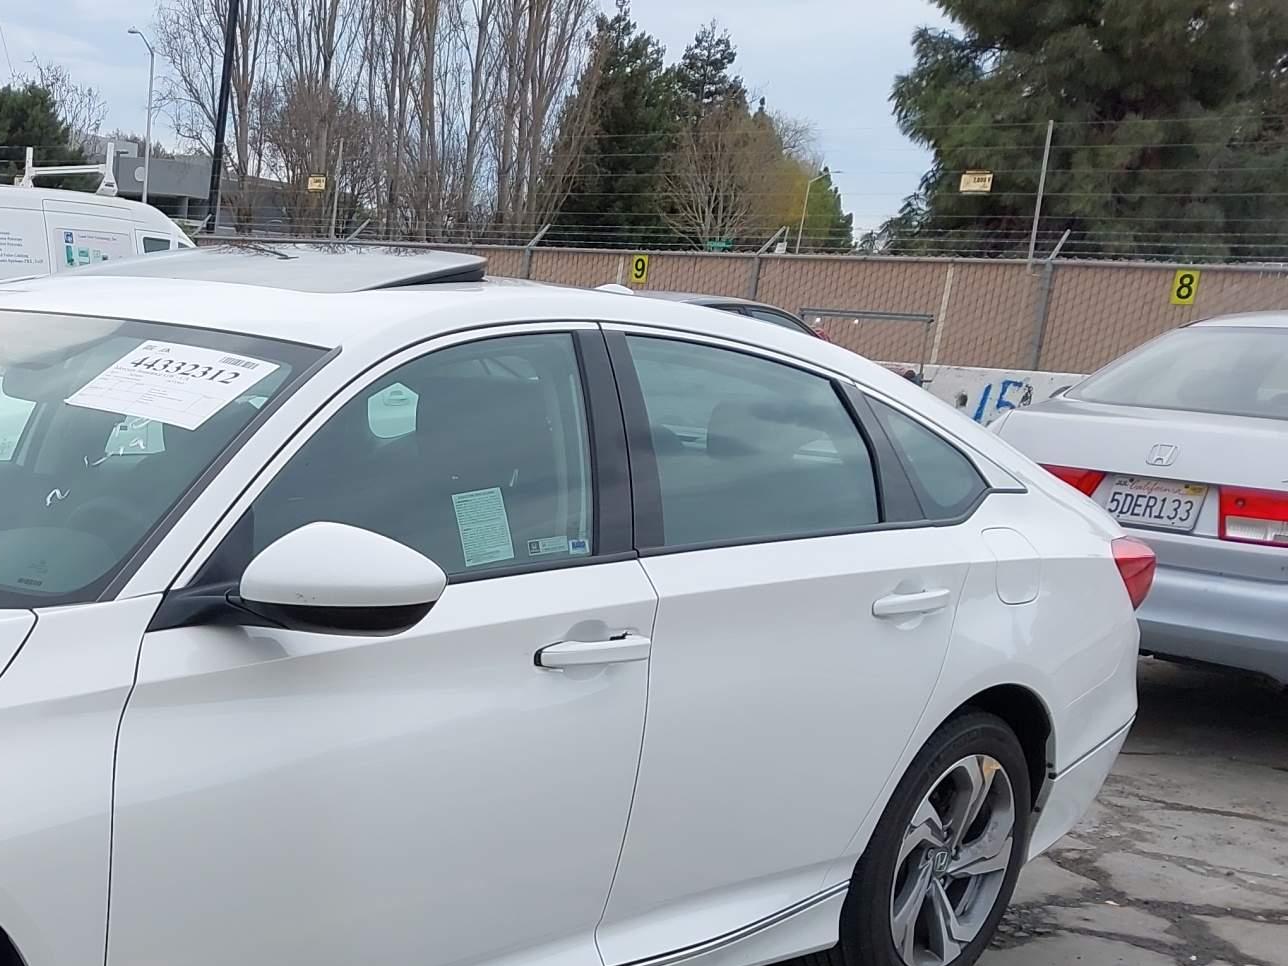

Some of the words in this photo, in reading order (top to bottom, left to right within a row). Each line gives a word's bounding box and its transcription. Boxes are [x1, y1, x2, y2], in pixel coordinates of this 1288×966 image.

[634, 258, 645, 279] 9
[1176, 273, 1194, 300] 8
[130, 356, 241, 385] 44332312
[1107, 491, 1194, 522] 5DER133
